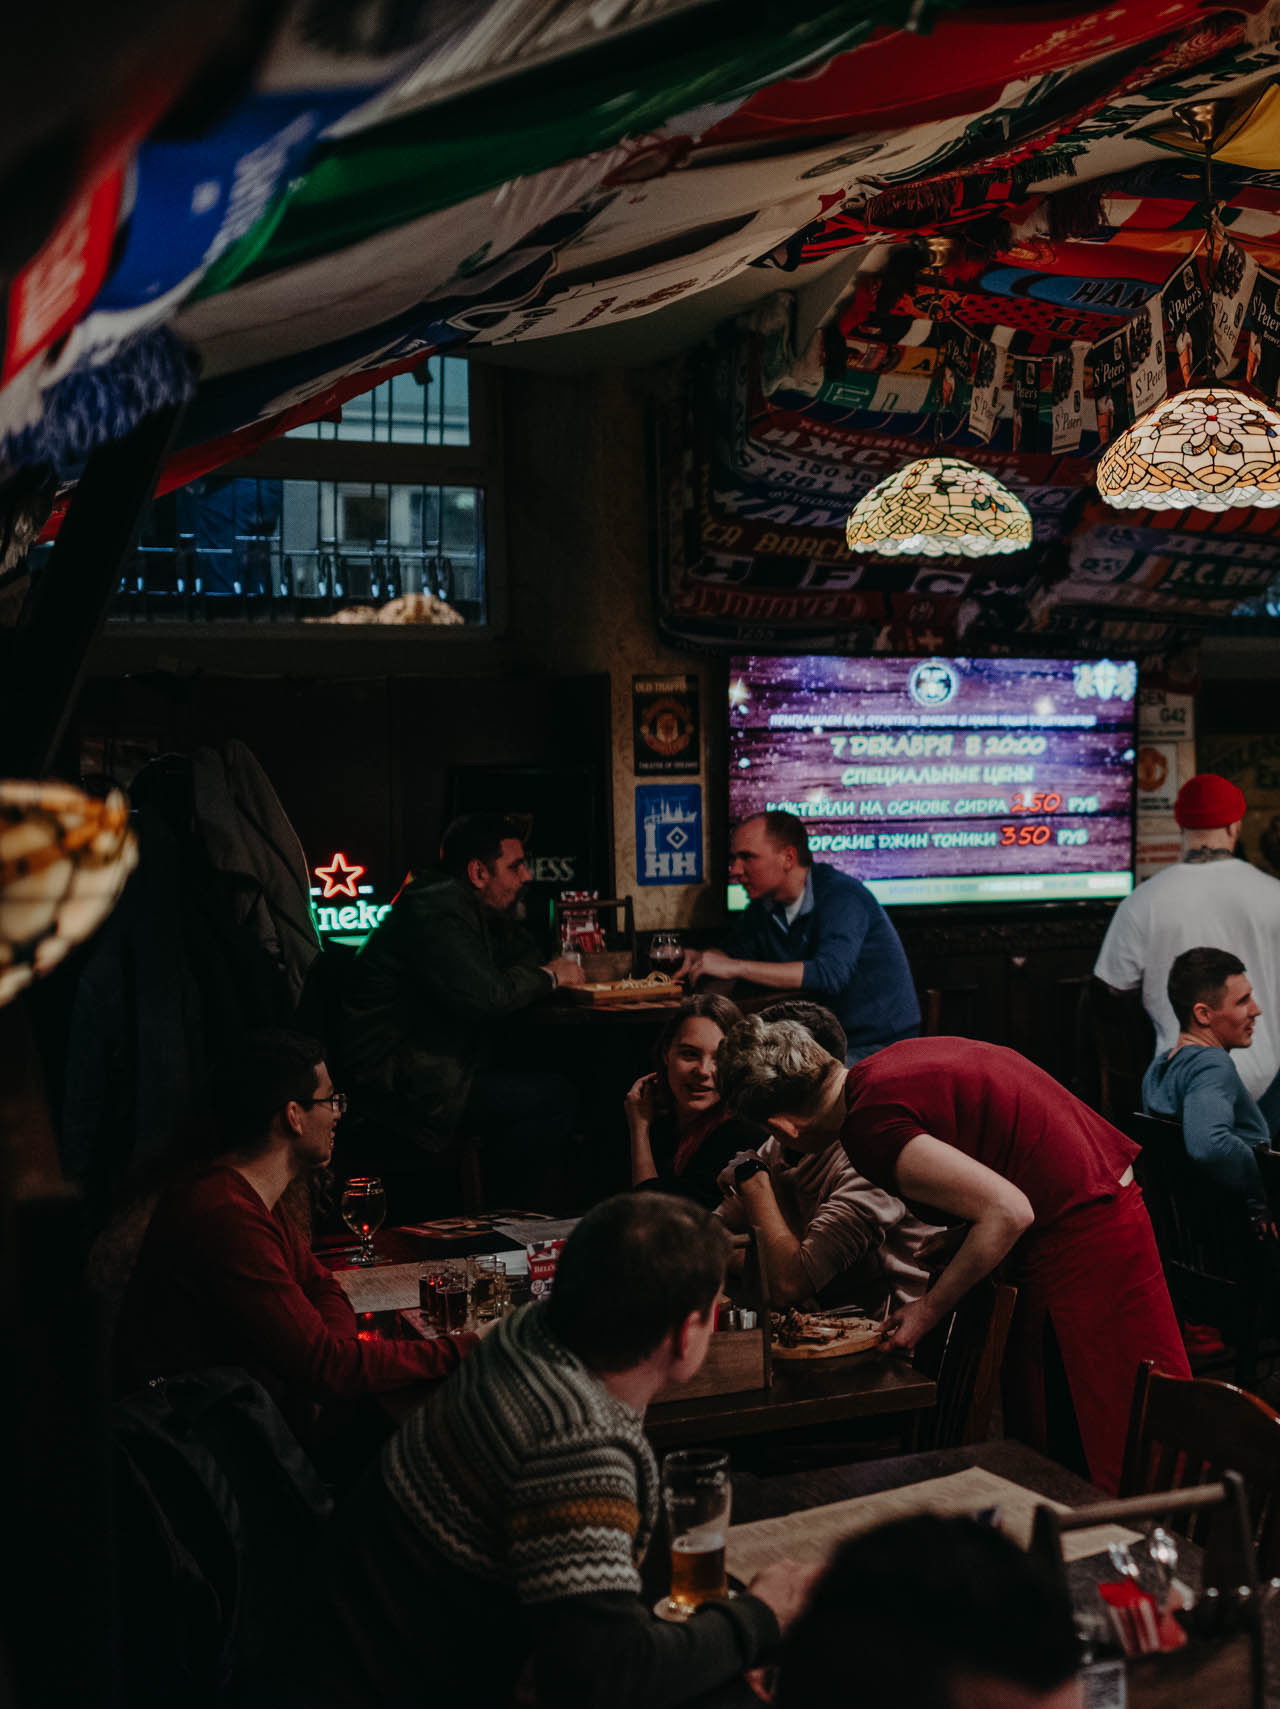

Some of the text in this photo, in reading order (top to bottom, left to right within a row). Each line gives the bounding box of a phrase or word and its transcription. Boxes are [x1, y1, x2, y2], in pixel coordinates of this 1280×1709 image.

[1174, 288, 1202, 321] Peter's
[830, 735, 1047, 758] 7 ДЕКАБРЯ В 20:00
[841, 766, 1035, 787] СПЕЦИАЛЬНЫЕ ЦЕНЫ
[859, 801, 885, 817] НА
[886, 800, 951, 816] ОСНОВЕ
[953, 799, 1010, 815] СИДРА
[1067, 796, 1100, 813] РУБ
[808, 826, 1089, 852] ОРСКИЕ ДЖИН ТОНИКИ 350 РУБ
[529, 855, 576, 882] ESS
